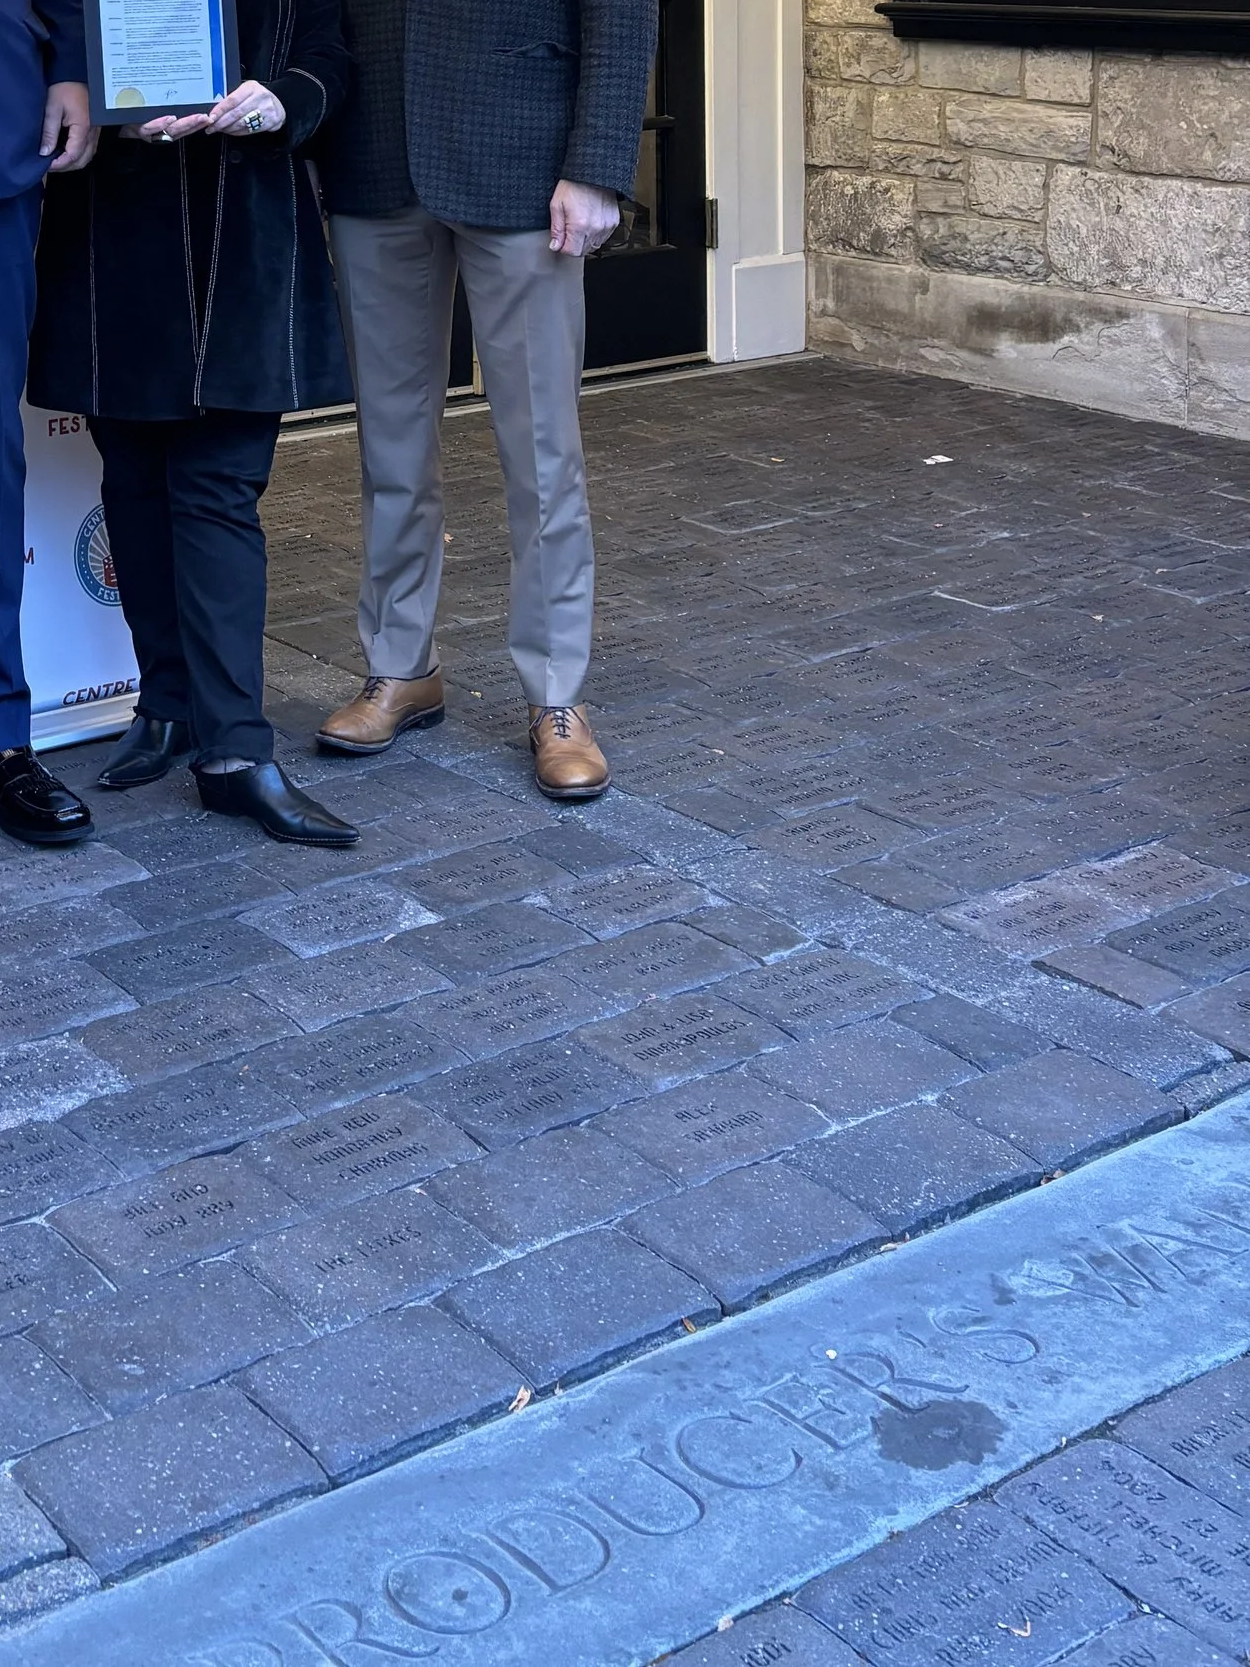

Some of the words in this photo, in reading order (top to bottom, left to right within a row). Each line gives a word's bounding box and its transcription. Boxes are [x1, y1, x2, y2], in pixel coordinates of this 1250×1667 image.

[62, 678, 137, 705] CENTRE
[617, 1027, 662, 1045] JOHN
[673, 1008, 714, 1024] LISA
[338, 1111, 383, 1130] REID
[187, 1304, 1040, 1667] RODUCER'S
